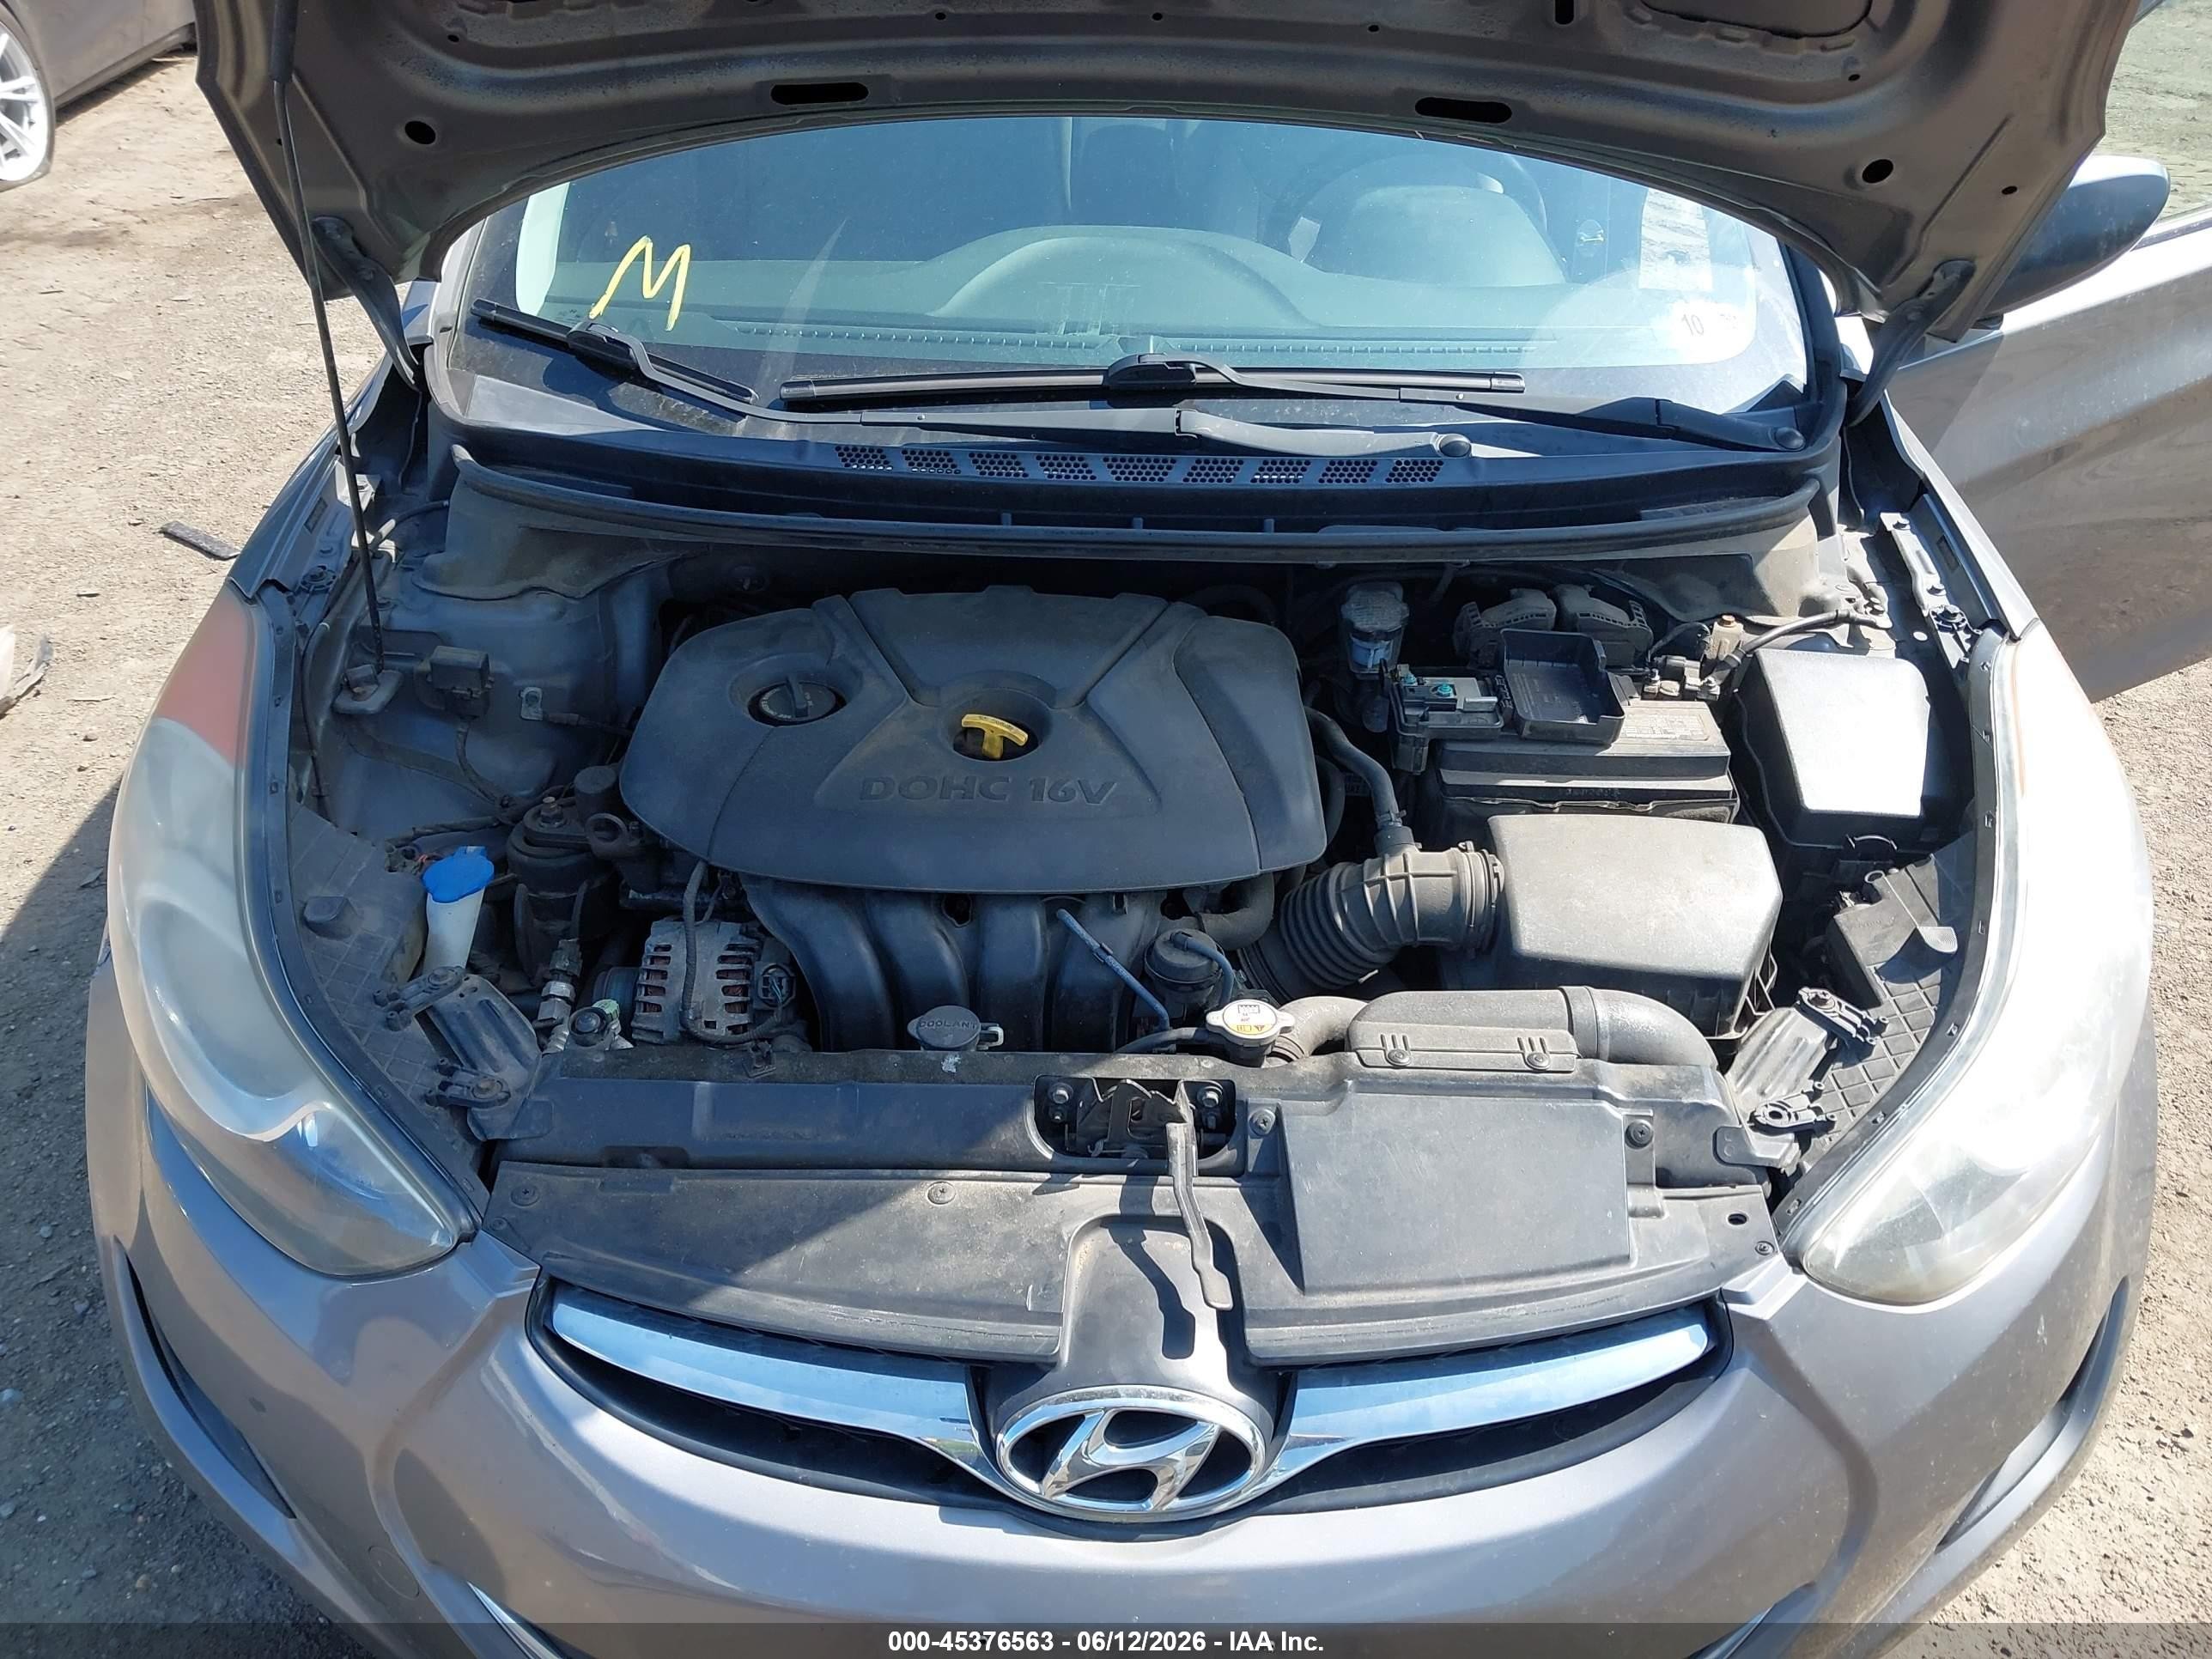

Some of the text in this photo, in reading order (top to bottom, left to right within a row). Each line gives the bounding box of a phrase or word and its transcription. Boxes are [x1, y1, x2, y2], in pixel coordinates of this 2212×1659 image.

[588, 234, 690, 331] M
[1681, 313, 1704, 335] 10
[859, 775, 1117, 805] DOHC 16V
[917, 1019, 978, 1030] COOLANT
